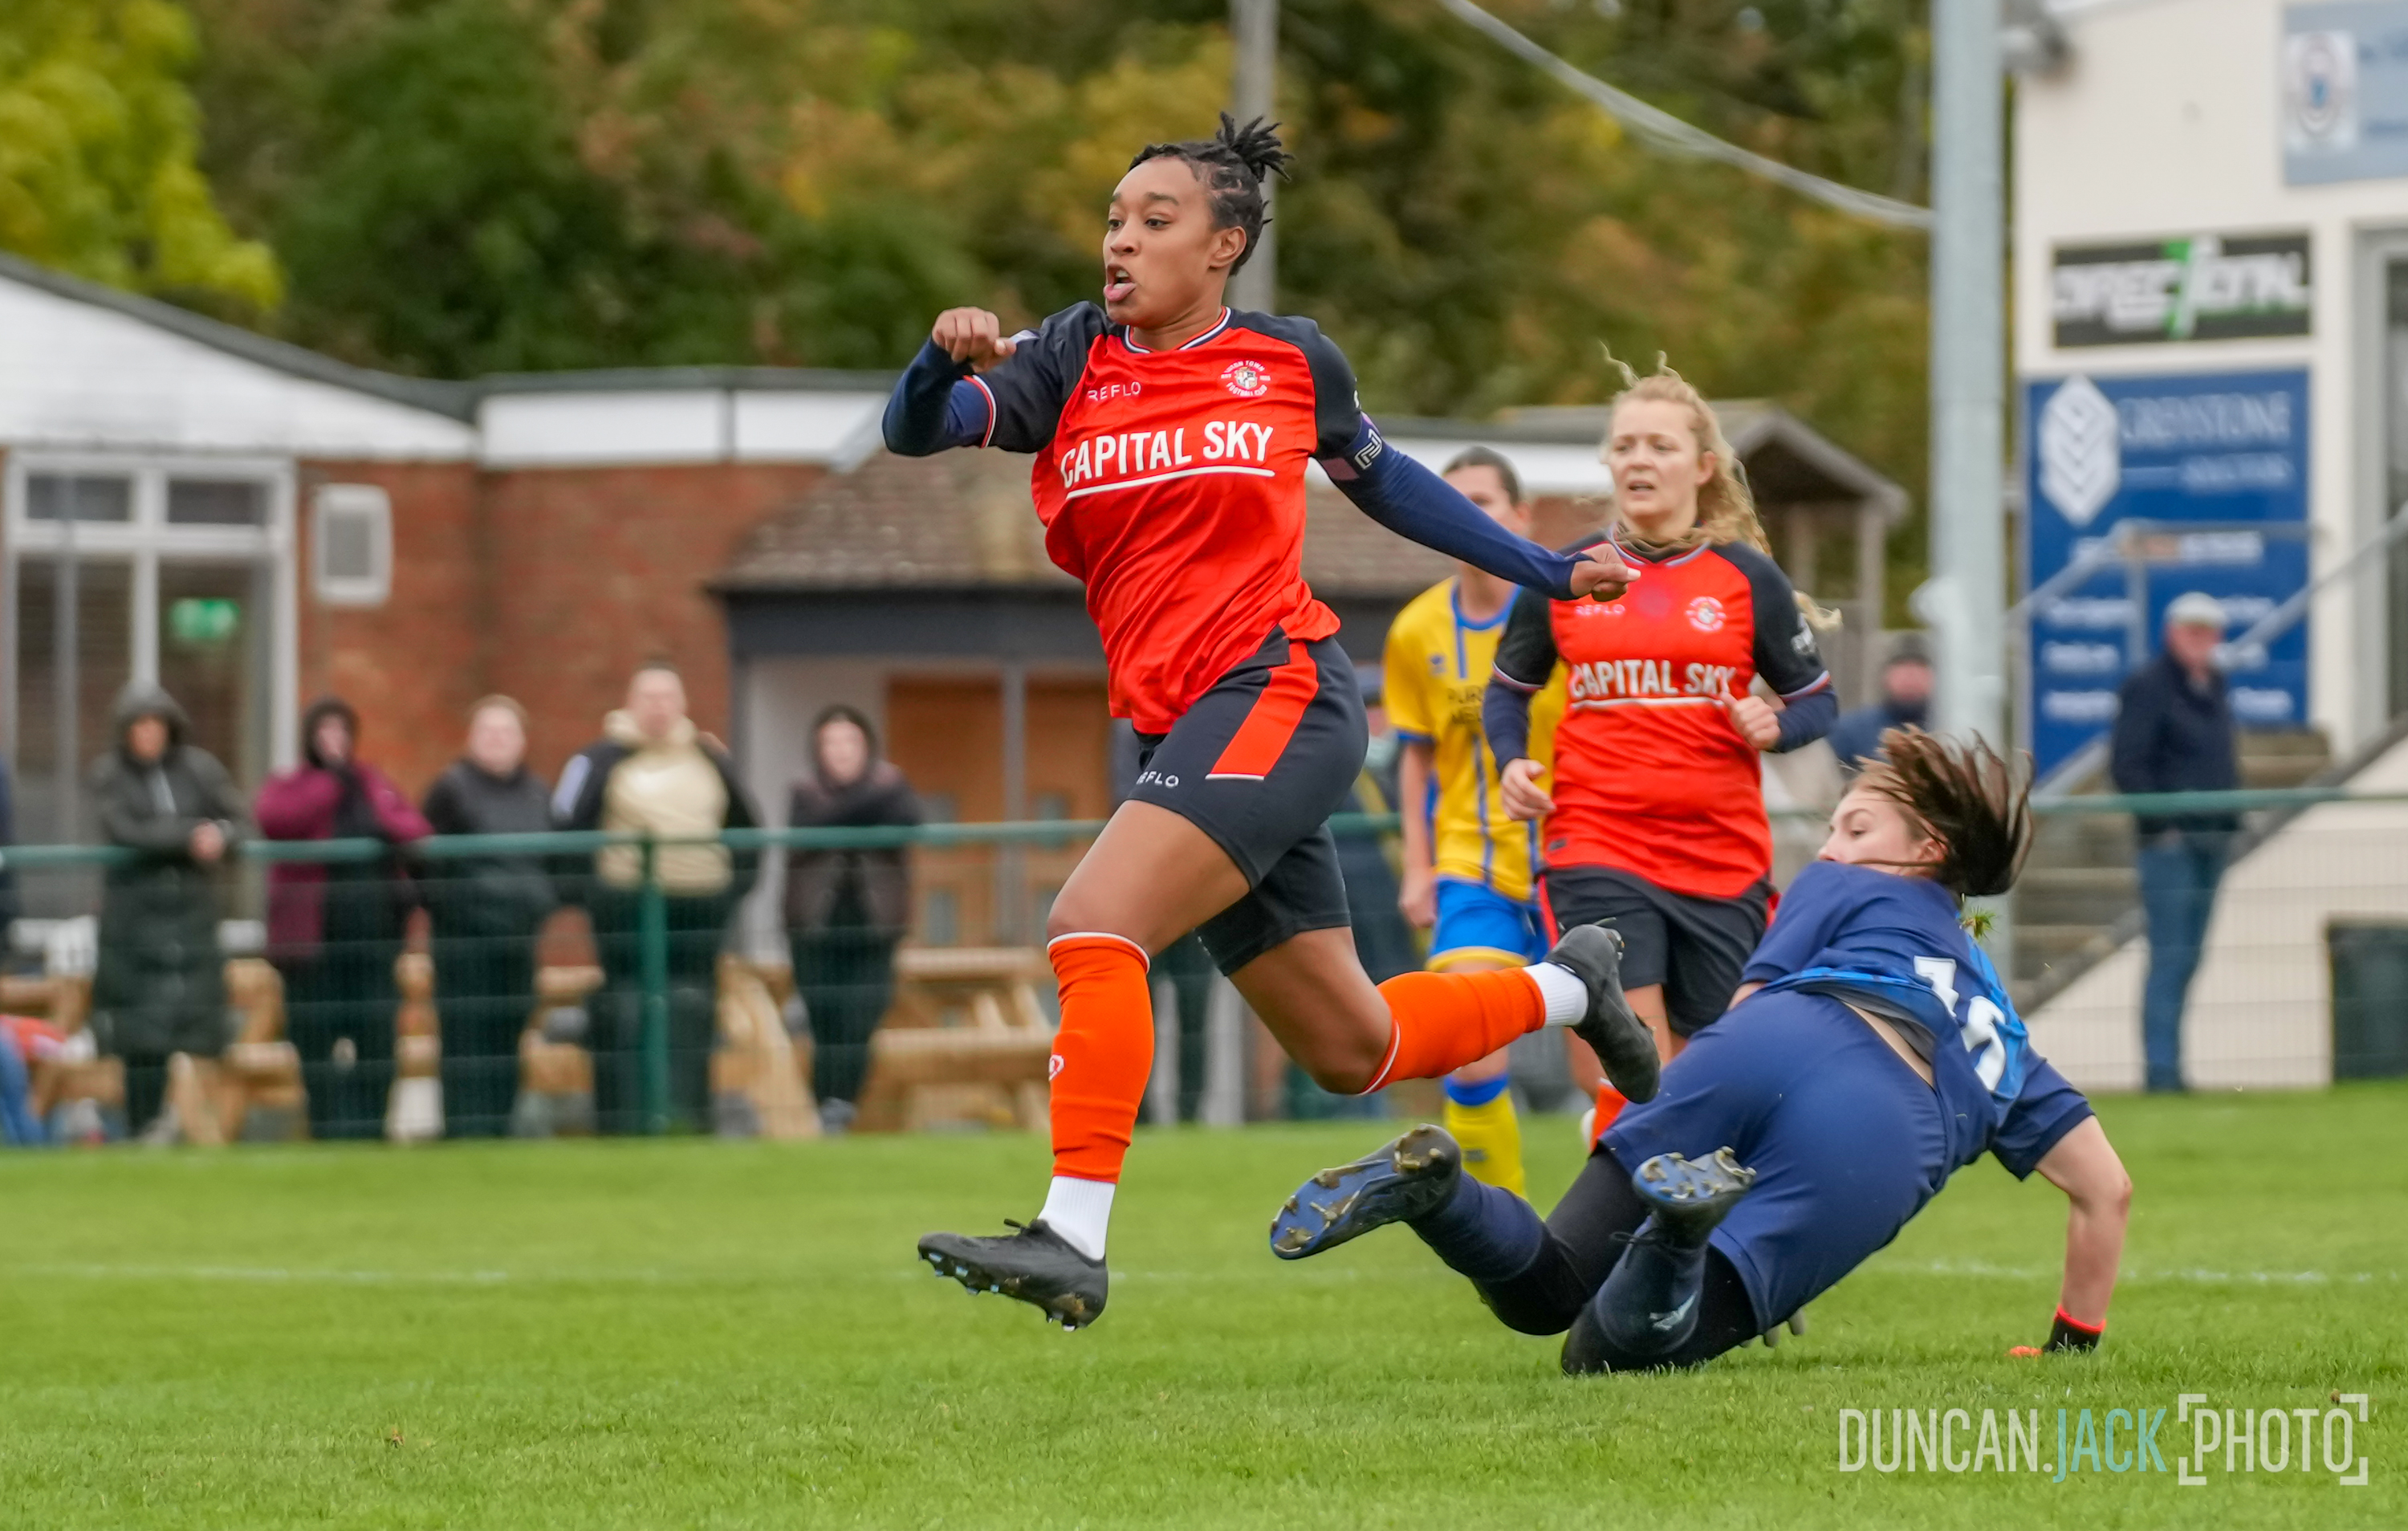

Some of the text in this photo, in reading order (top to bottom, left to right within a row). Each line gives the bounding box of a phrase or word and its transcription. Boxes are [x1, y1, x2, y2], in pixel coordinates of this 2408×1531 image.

[1088, 381, 1141, 401] REFLO
[1060, 421, 1274, 489] CAPITAL SKY
[1571, 659, 1736, 698] CAPITAL SKY
